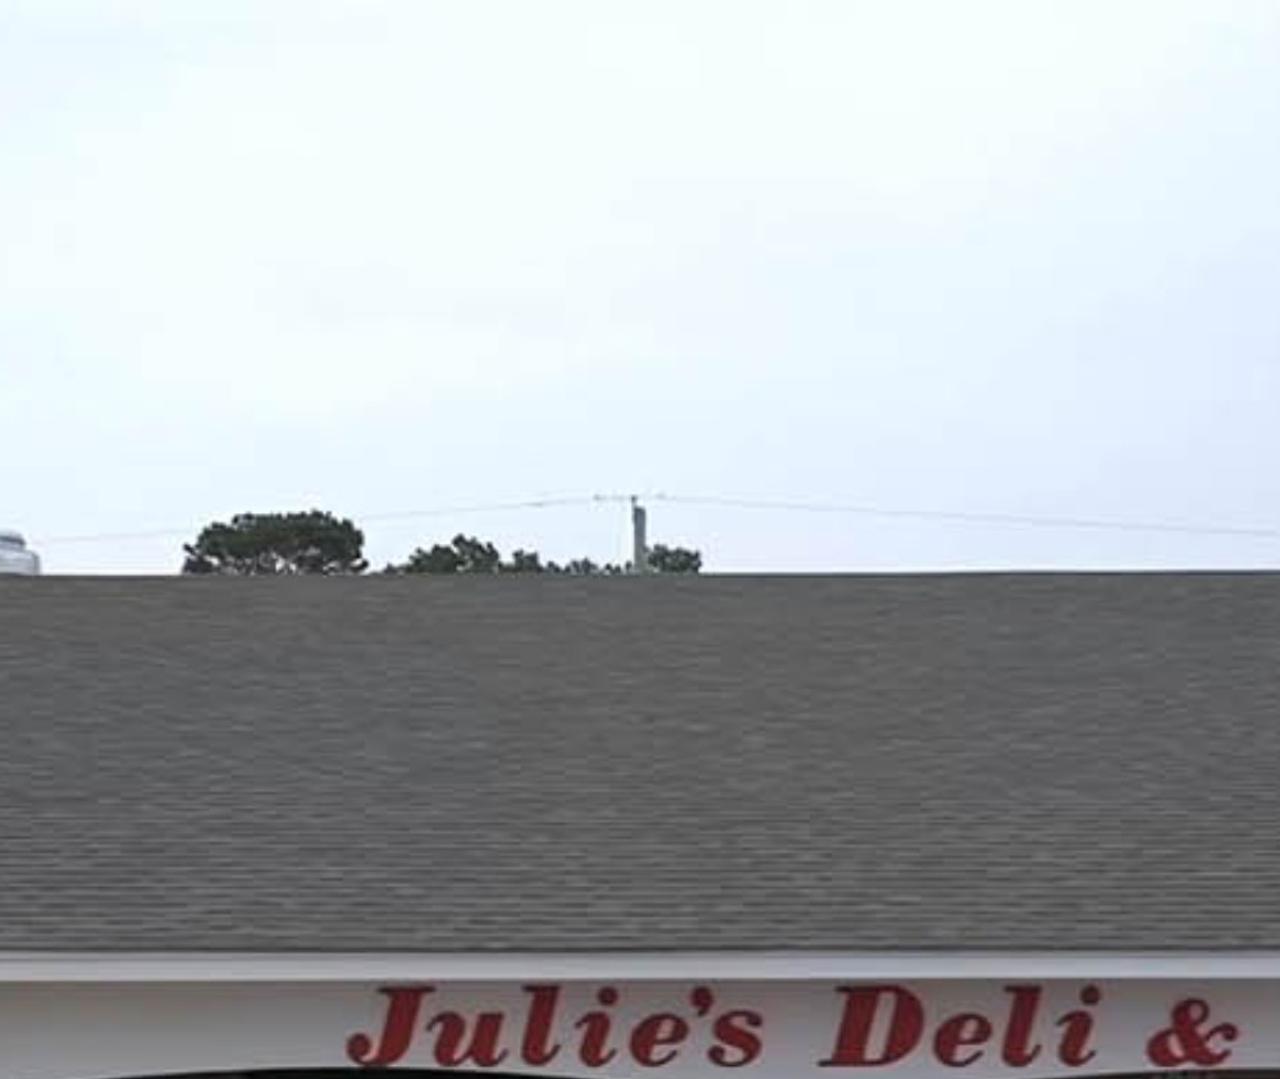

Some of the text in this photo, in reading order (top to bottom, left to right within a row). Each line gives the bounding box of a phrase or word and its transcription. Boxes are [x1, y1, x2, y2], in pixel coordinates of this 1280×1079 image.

[346, 983, 763, 1067] Julie's
[817, 983, 1103, 1068] Deli
[1146, 998, 1239, 1066] &
